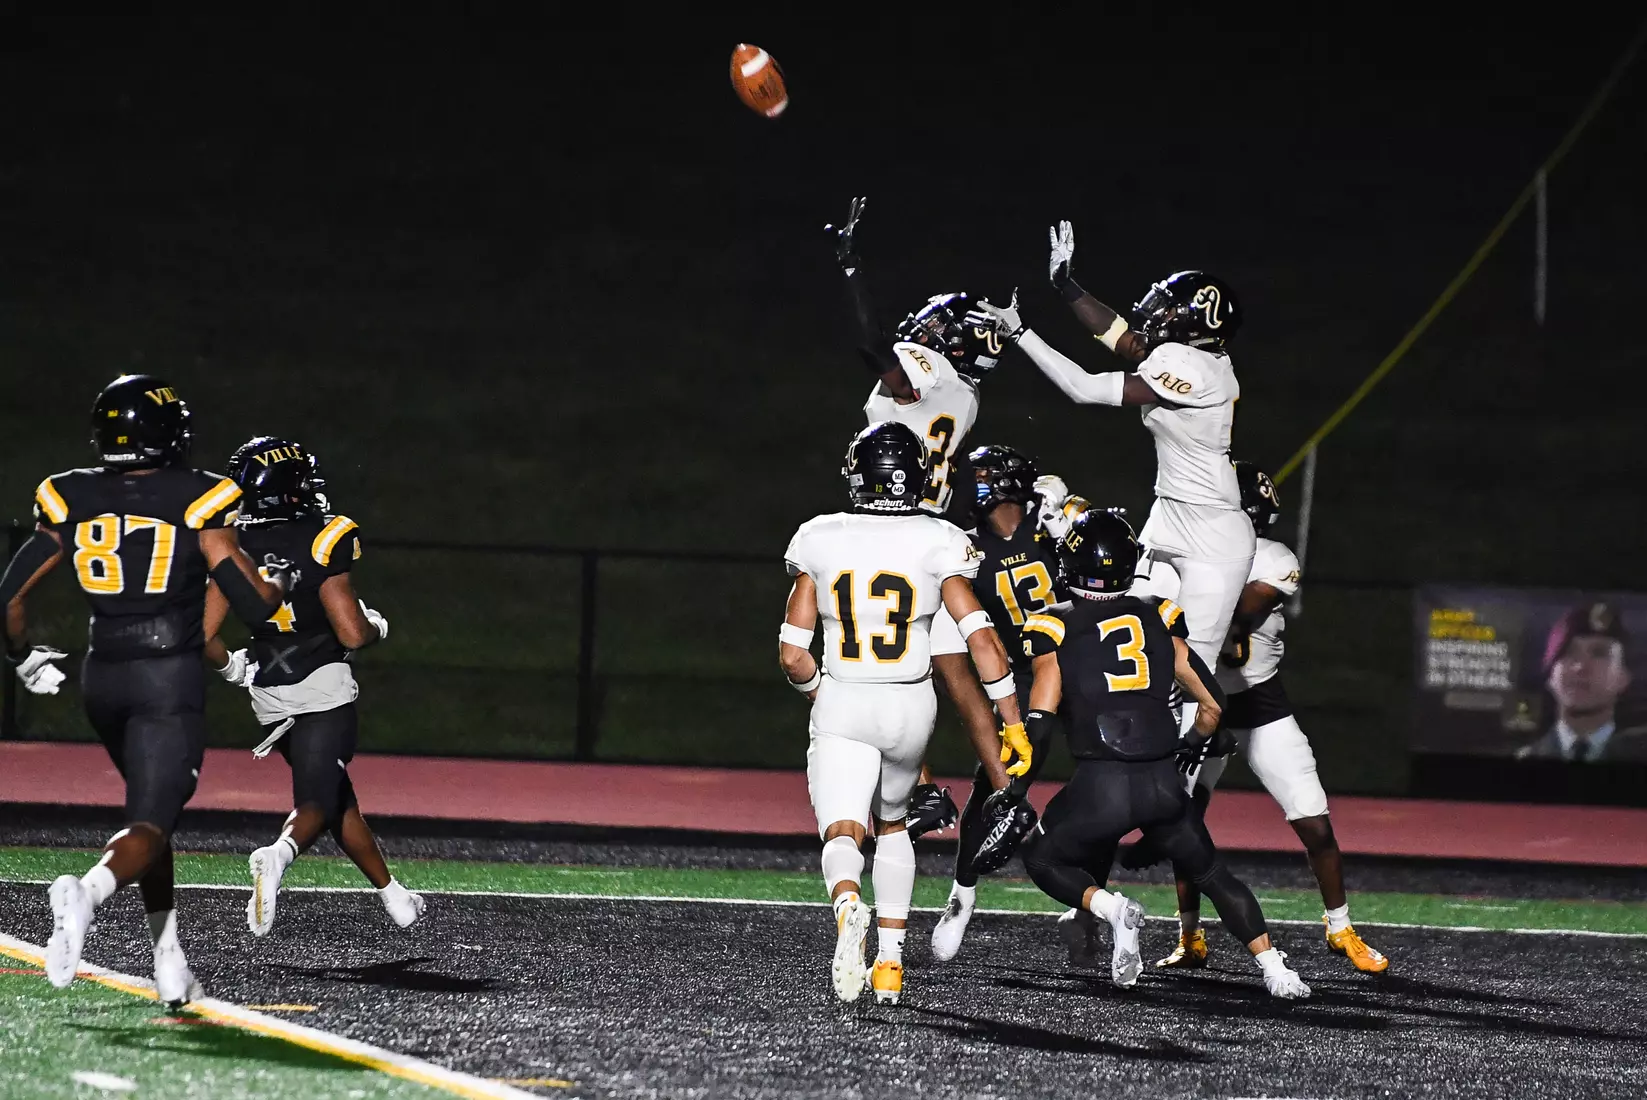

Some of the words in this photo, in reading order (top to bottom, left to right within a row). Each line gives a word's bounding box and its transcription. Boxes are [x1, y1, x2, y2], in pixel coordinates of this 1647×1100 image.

[1150, 371, 1192, 394] AIC
[252, 446, 304, 467] VILLE
[875, 484, 883, 493] 13
[873, 497, 905, 507] schutt
[74, 513, 177, 594] 87
[1000, 552, 1028, 567] VILLE
[995, 560, 1058, 626] 13
[831, 569, 917, 664] 13
[1097, 613, 1151, 693] 3
